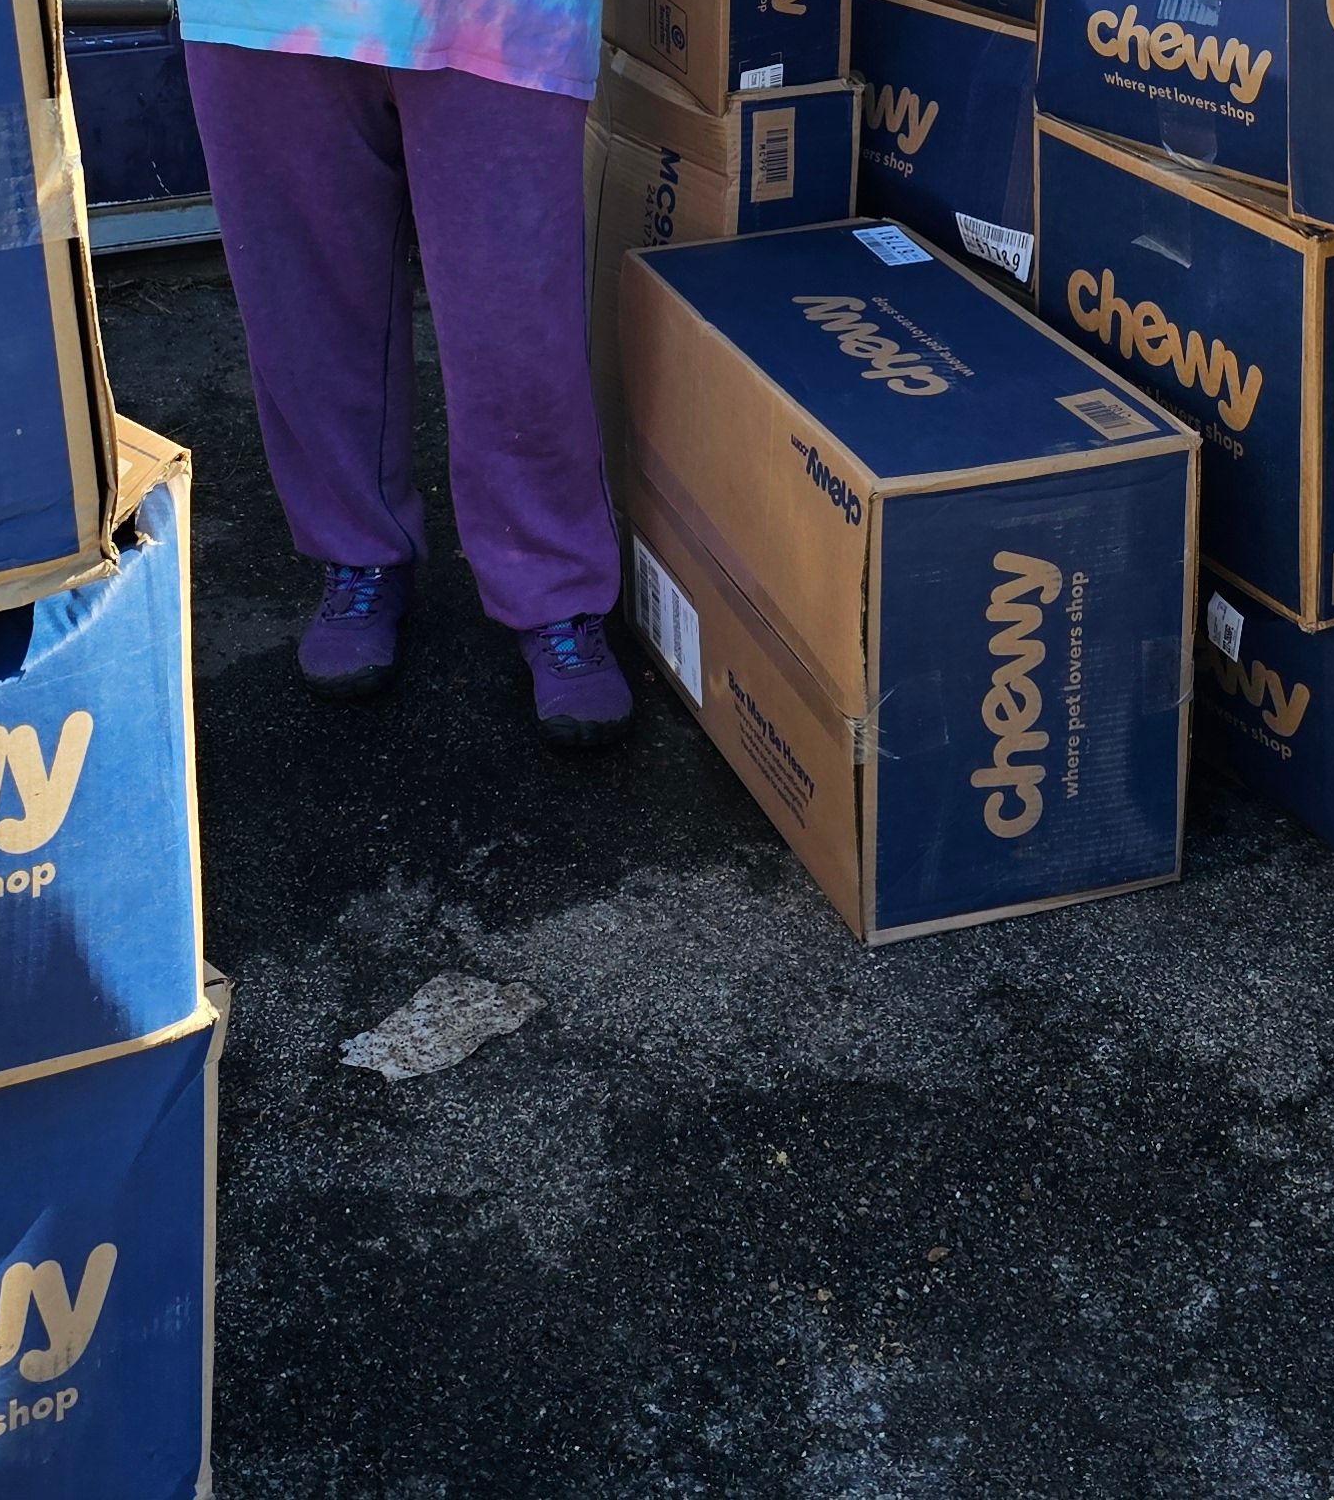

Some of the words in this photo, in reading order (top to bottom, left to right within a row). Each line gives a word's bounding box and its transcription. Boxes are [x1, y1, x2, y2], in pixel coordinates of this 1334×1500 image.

[1087, 4, 1272, 104] chewy
[1104, 71, 1146, 93] where
[1149, 84, 1172, 100] pet
[1174, 87, 1217, 112] lovers
[1220, 101, 1255, 126] shop
[759, 143, 767, 172] MC99
[863, 148, 881, 163] ers
[883, 152, 914, 178] shop
[872, 296, 898, 315] shop
[893, 314, 922, 339] lovers
[919, 336, 949, 354] pet
[791, 296, 949, 396] chewy
[939, 349, 975, 377] where
[1067, 268, 1263, 432] chewy
[1205, 422, 1244, 460] shop
[1066, 571, 1089, 622] shop
[1065, 626, 1083, 691] lovers
[970, 550, 1063, 838] chewy
[1066, 692, 1085, 730] pet
[1251, 728, 1292, 760] shop
[1062, 738, 1080, 799] where
